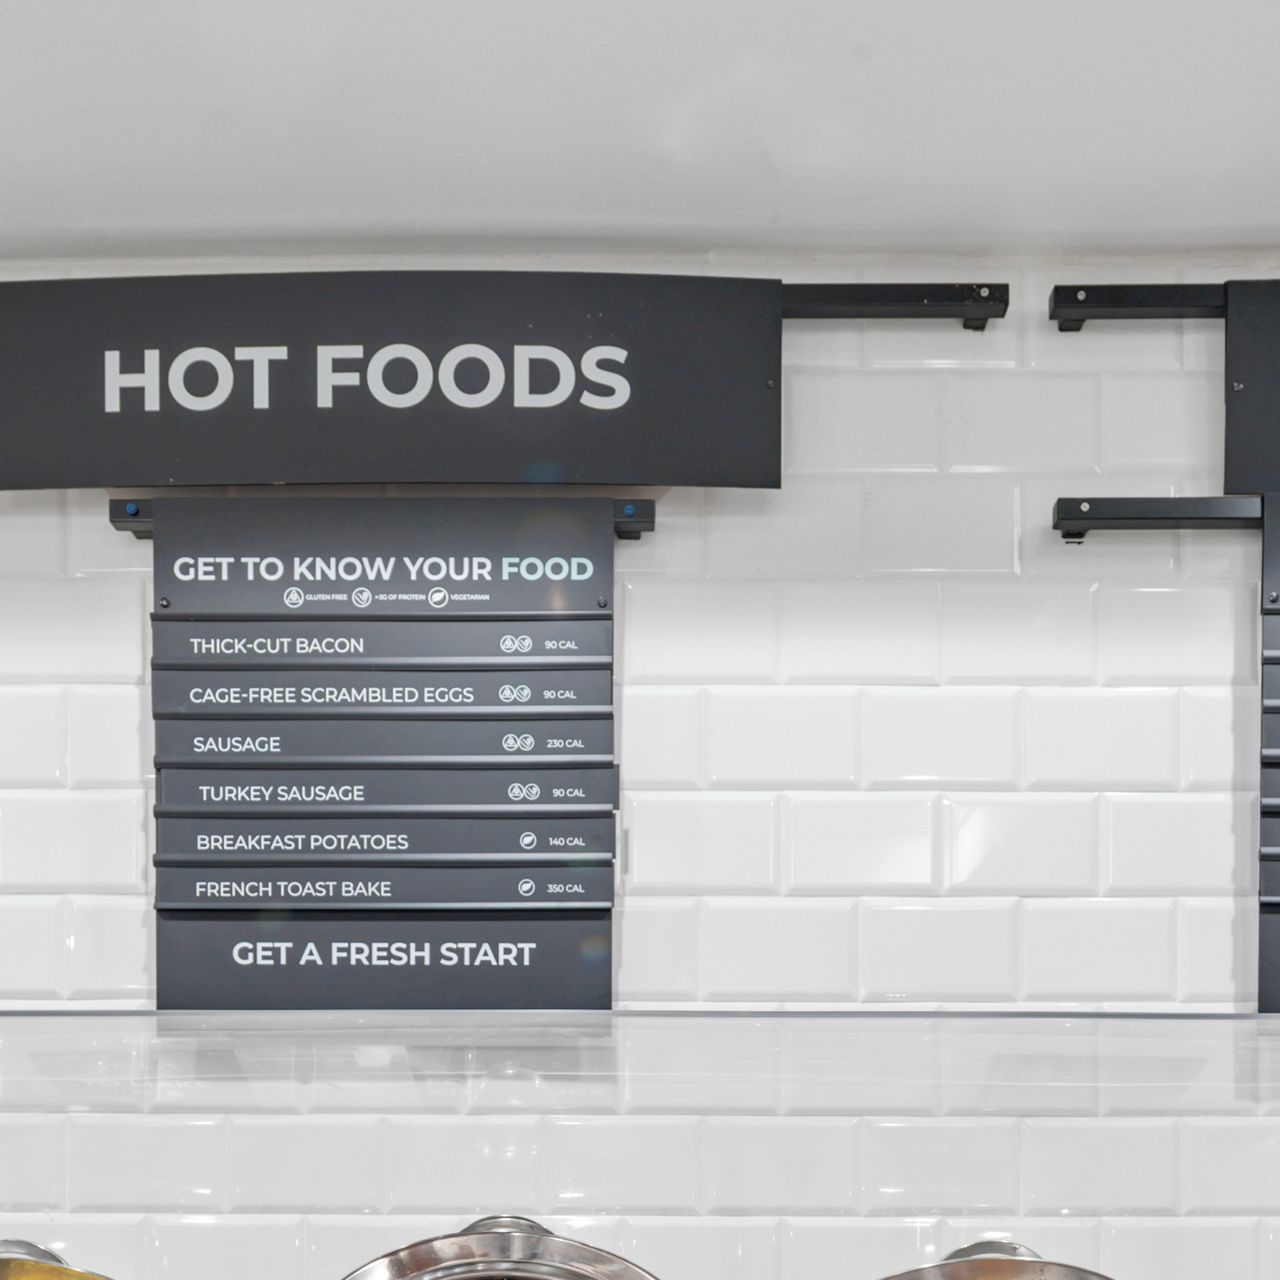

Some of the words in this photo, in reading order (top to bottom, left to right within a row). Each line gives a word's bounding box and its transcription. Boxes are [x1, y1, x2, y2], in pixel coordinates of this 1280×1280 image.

[105, 346, 288, 412] HOT
[317, 344, 630, 409] FOODS
[174, 557, 234, 581] GET
[241, 557, 284, 581] TO
[294, 557, 395, 581] KNOW
[403, 557, 492, 581] YOUR
[502, 557, 593, 580] FOOD
[190, 638, 291, 653] THICK-CUT
[296, 638, 363, 653] BACON
[545, 641, 557, 649] 90
[559, 641, 578, 649] CAL
[190, 688, 296, 703] CAGE-FREE
[301, 688, 418, 702] SCRAMBLED
[424, 688, 474, 702] EGGS
[543, 690, 556, 699] 90
[557, 690, 576, 698] CAL
[194, 737, 280, 752] SAUSAGE
[547, 739, 564, 748] 230
[565, 739, 584, 747] CAL
[199, 786, 273, 801] TURKEY
[278, 786, 364, 801] SAUSAGE
[553, 789, 565, 797] 90
[566, 789, 585, 797] CAL
[197, 835, 306, 850] BREAKFAST
[311, 835, 408, 849] POTATOES
[549, 838, 565, 846] 140
[566, 837, 585, 846] CAL
[196, 882, 272, 896] FRENCH
[277, 882, 337, 896] TOAST
[342, 882, 391, 896] BAKE
[547, 884, 564, 892] 350
[566, 884, 584, 892] CAL
[233, 942, 293, 965] GET
[300, 943, 322, 965] A
[332, 943, 430, 965] FRESH
[440, 943, 536, 965] START
